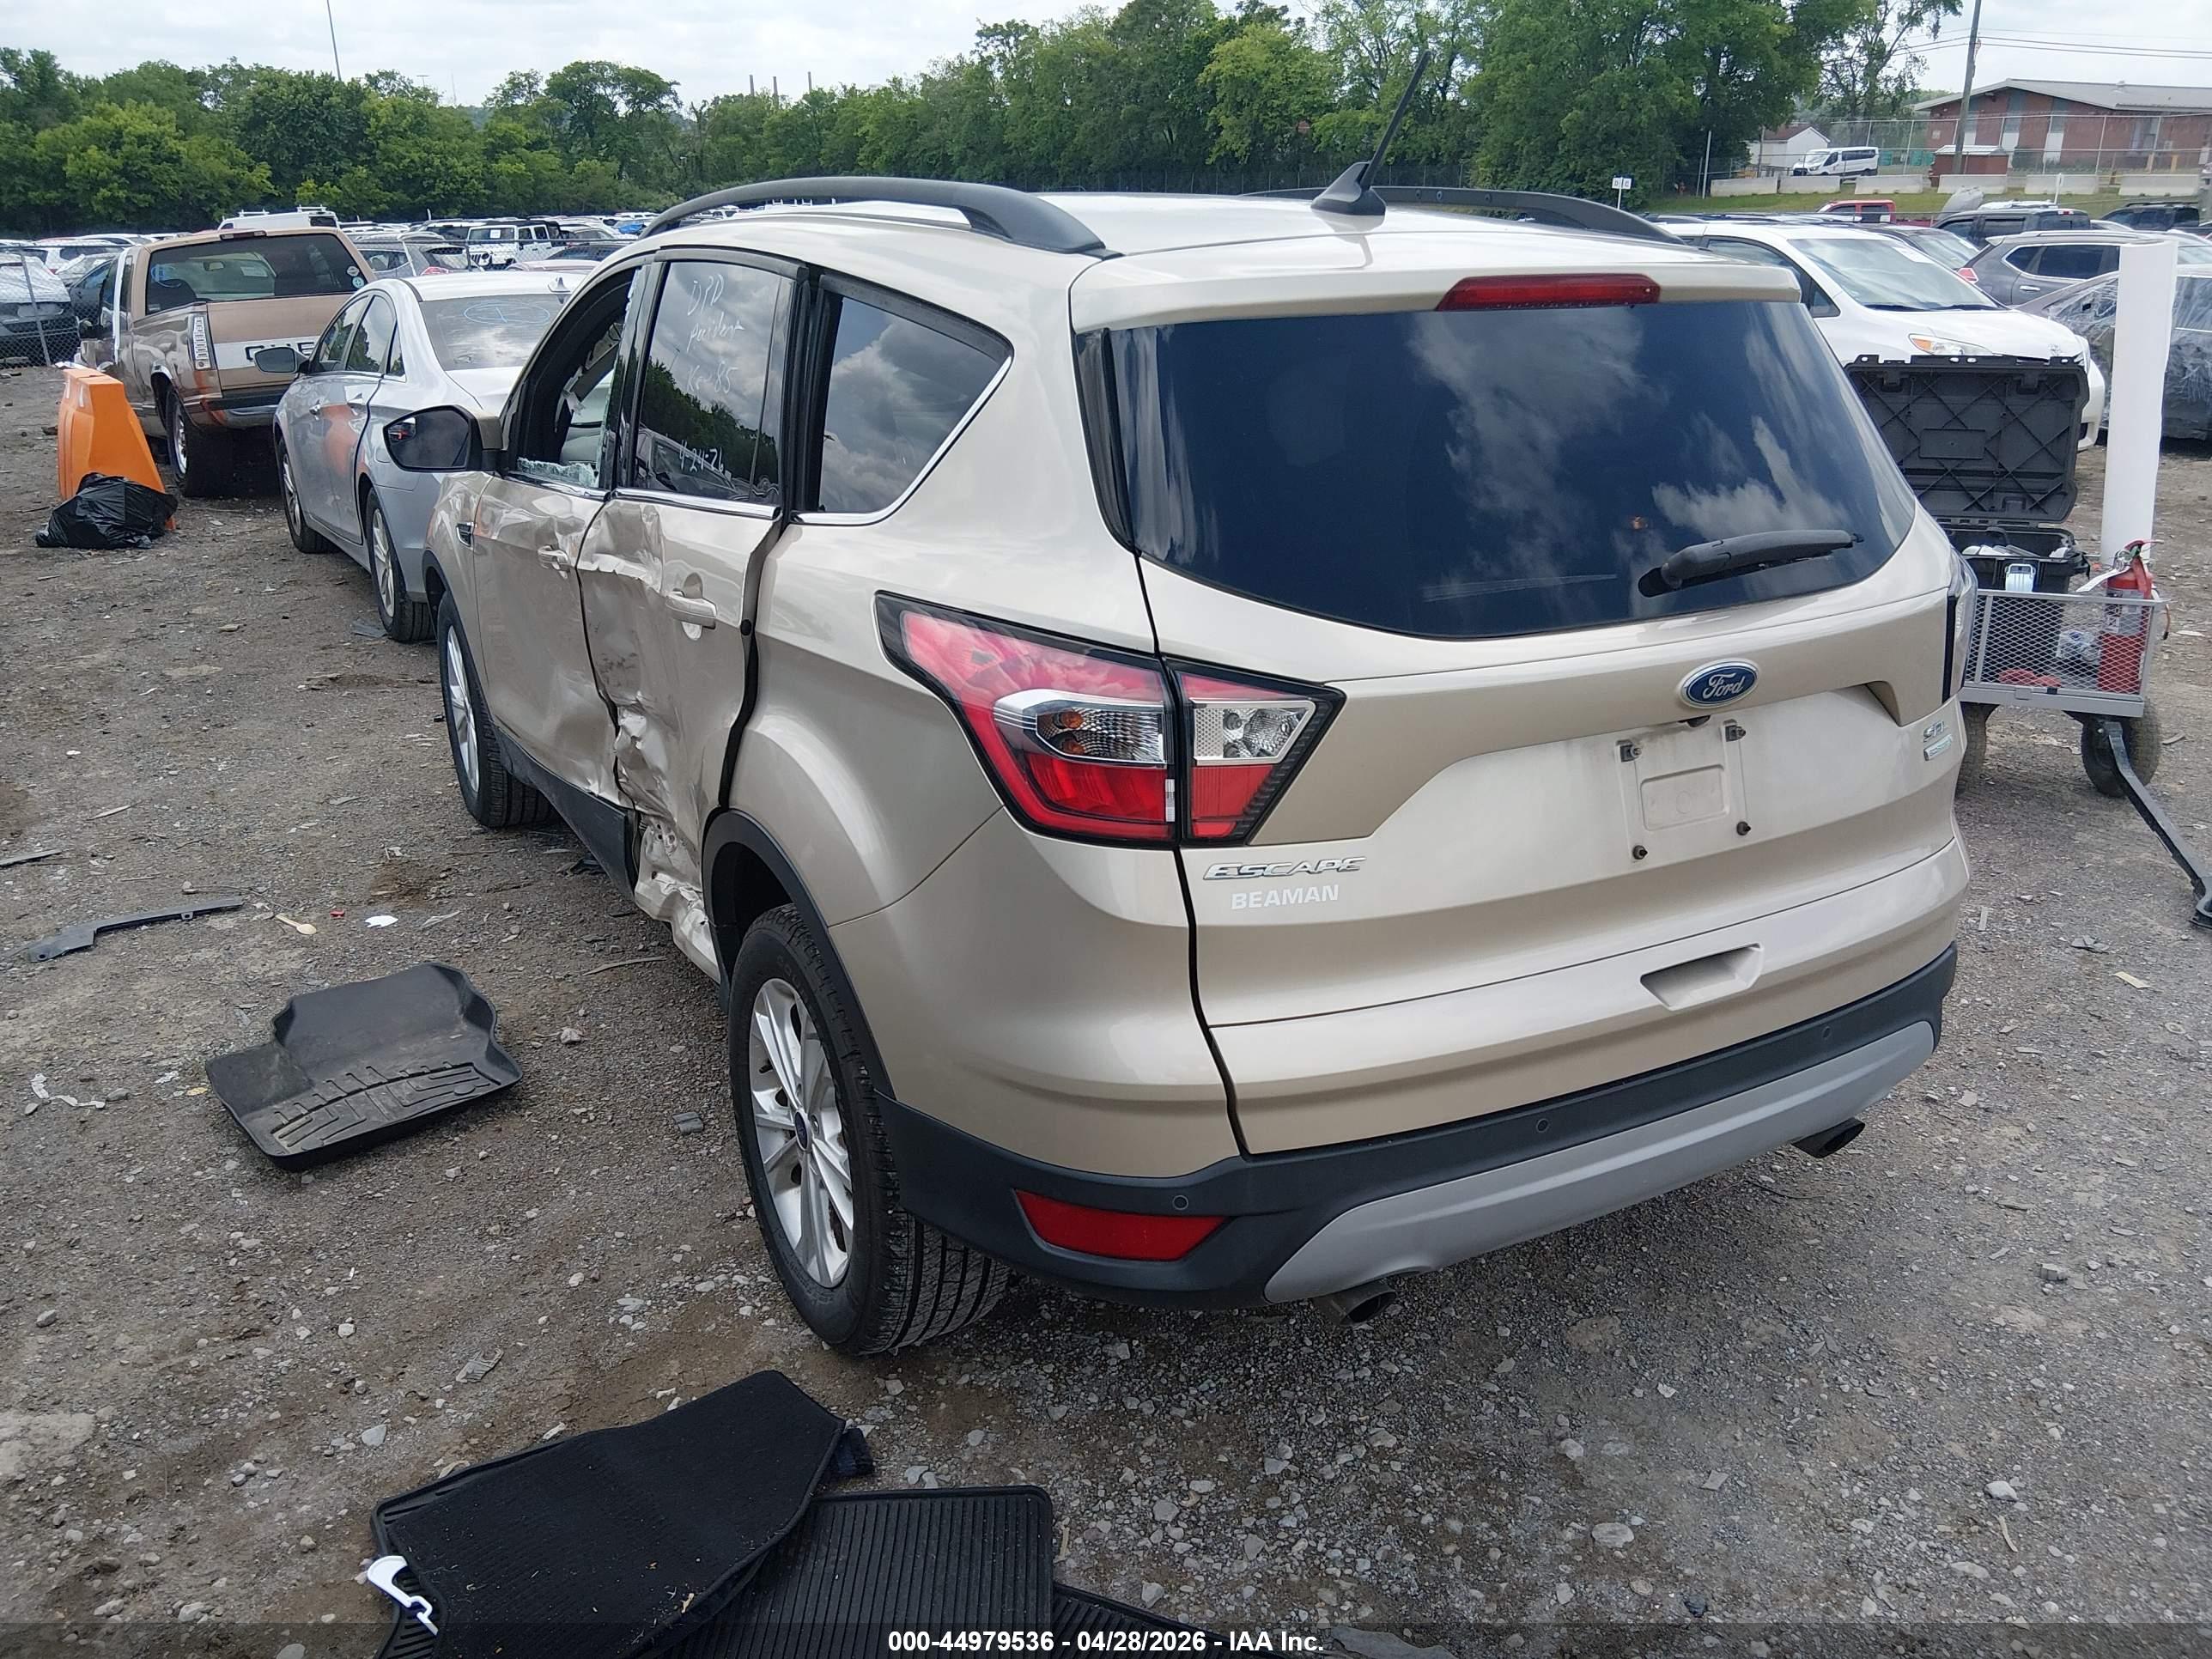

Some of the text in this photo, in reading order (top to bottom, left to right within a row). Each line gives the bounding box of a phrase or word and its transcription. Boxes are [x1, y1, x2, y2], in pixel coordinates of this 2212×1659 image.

[1702, 672, 1746, 700] Ford
[1203, 856, 1367, 881] ESCAPE
[1230, 884, 1340, 910] BEAMAN
